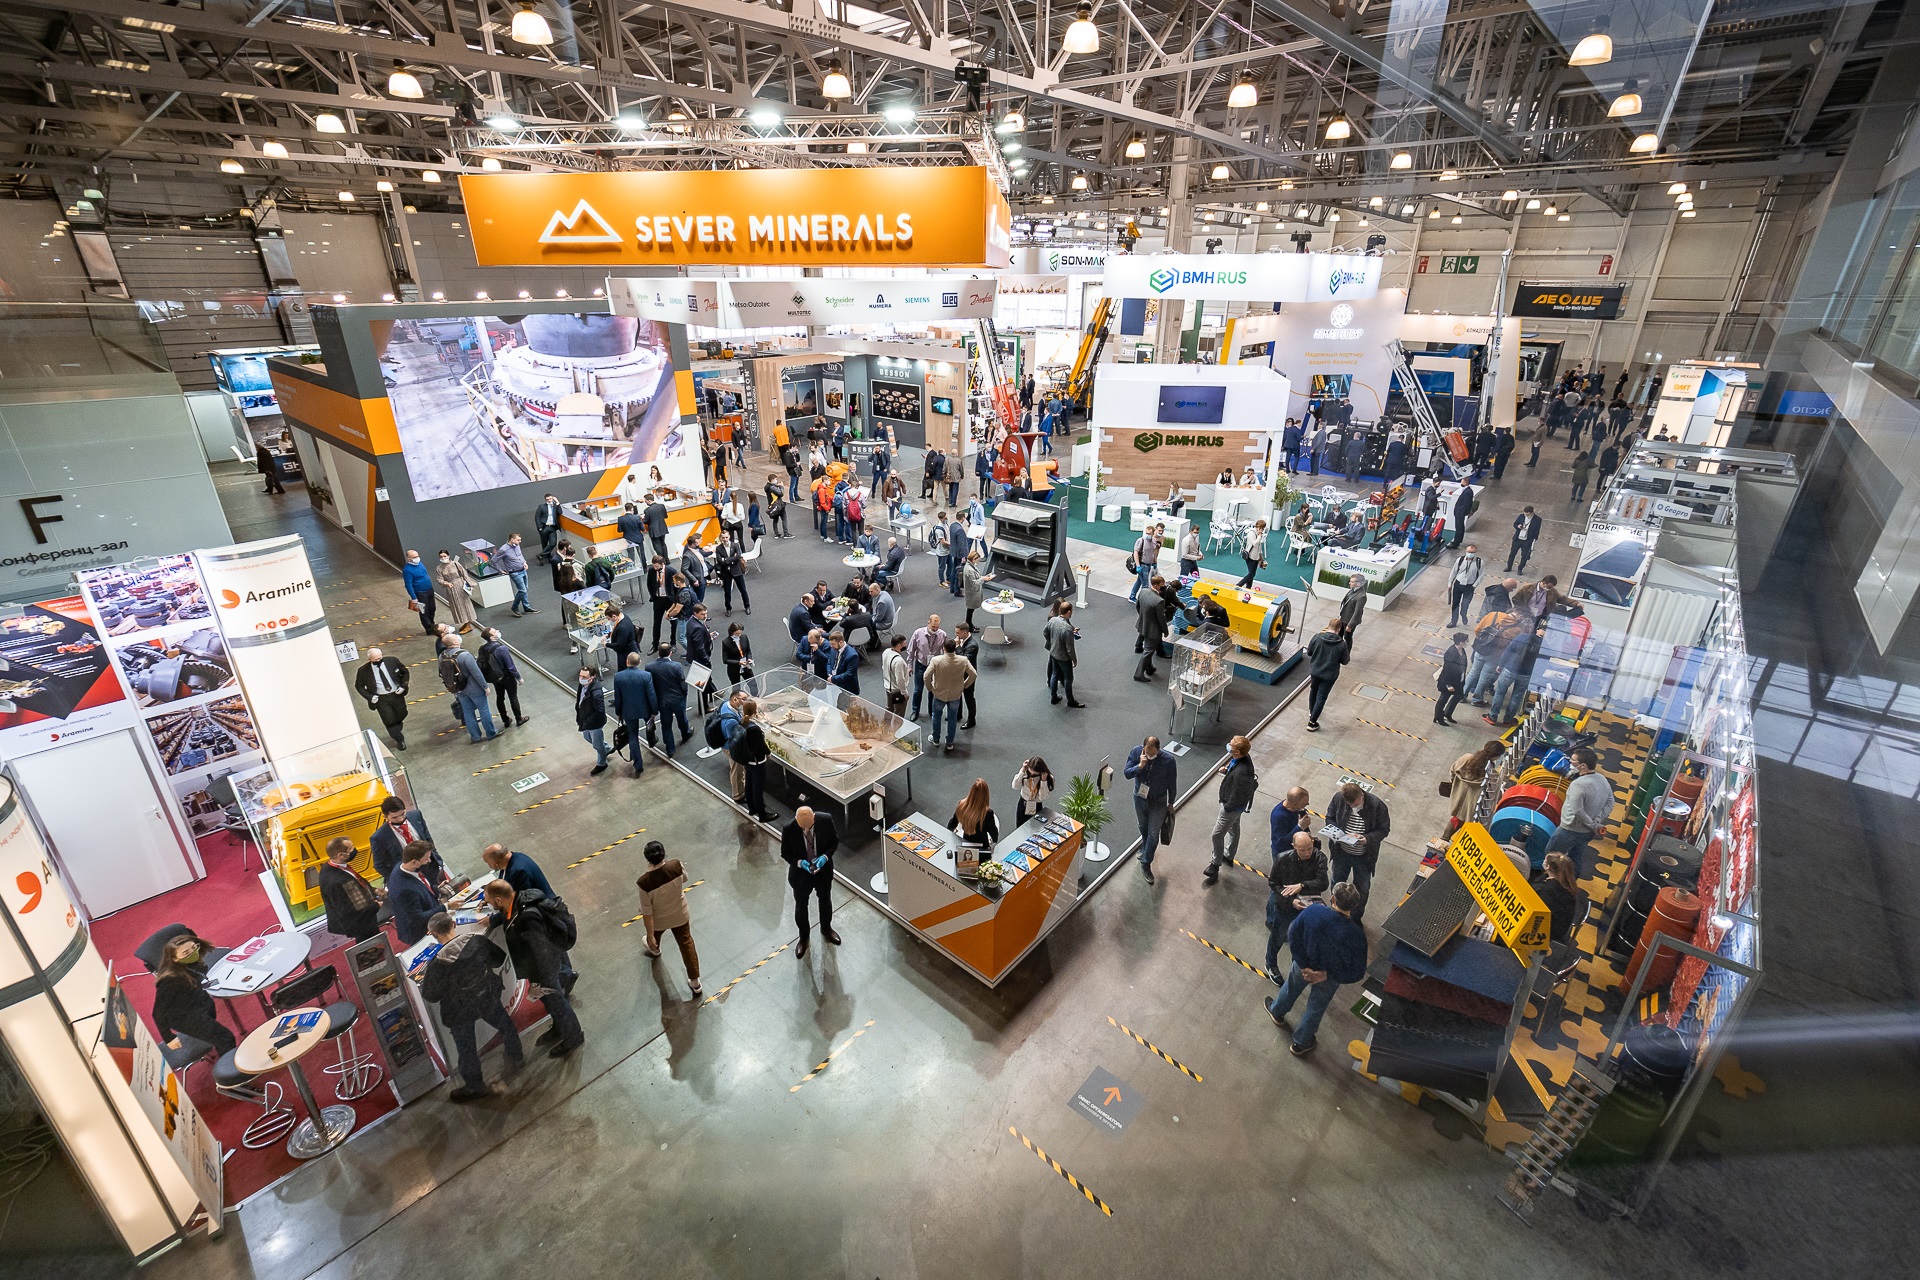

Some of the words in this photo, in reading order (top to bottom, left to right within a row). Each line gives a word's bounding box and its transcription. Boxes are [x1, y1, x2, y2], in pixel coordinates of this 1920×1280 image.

[636, 216, 736, 243] SEVER
[749, 213, 913, 242] MINERALS
[1182, 271, 1215, 285] BMH
[1217, 270, 1247, 285] RUS
[1343, 273, 1355, 286] BMH
[1355, 271, 1365, 284] RUS
[825, 296, 855, 305] Schneider
[1532, 294, 1604, 305] AEOLUS
[879, 368, 911, 379] BESSON
[1165, 434, 1195, 446] BMH
[1196, 435, 1224, 447] RUS
[852, 445, 885, 454] BESSN
[1664, 504, 1689, 518] Geopro
[19, 494, 64, 544] F
[0, 541, 129, 568] онференц-зал
[18, 560, 86, 577] Conference
[90, 555, 114, 565] Hall
[1345, 563, 1363, 574] BMH
[1363, 565, 1378, 577] RUS
[245, 579, 312, 604] Aramine
[61, 726, 94, 738] Aramine
[908, 859, 926, 873] SEVER
[927, 871, 956, 893] MINERALS
[1459, 831, 1487, 871] КОВРЫ
[1480, 864, 1526, 923] ДРАЖНЫЕ
[1496, 910, 1515, 937] МОХ
